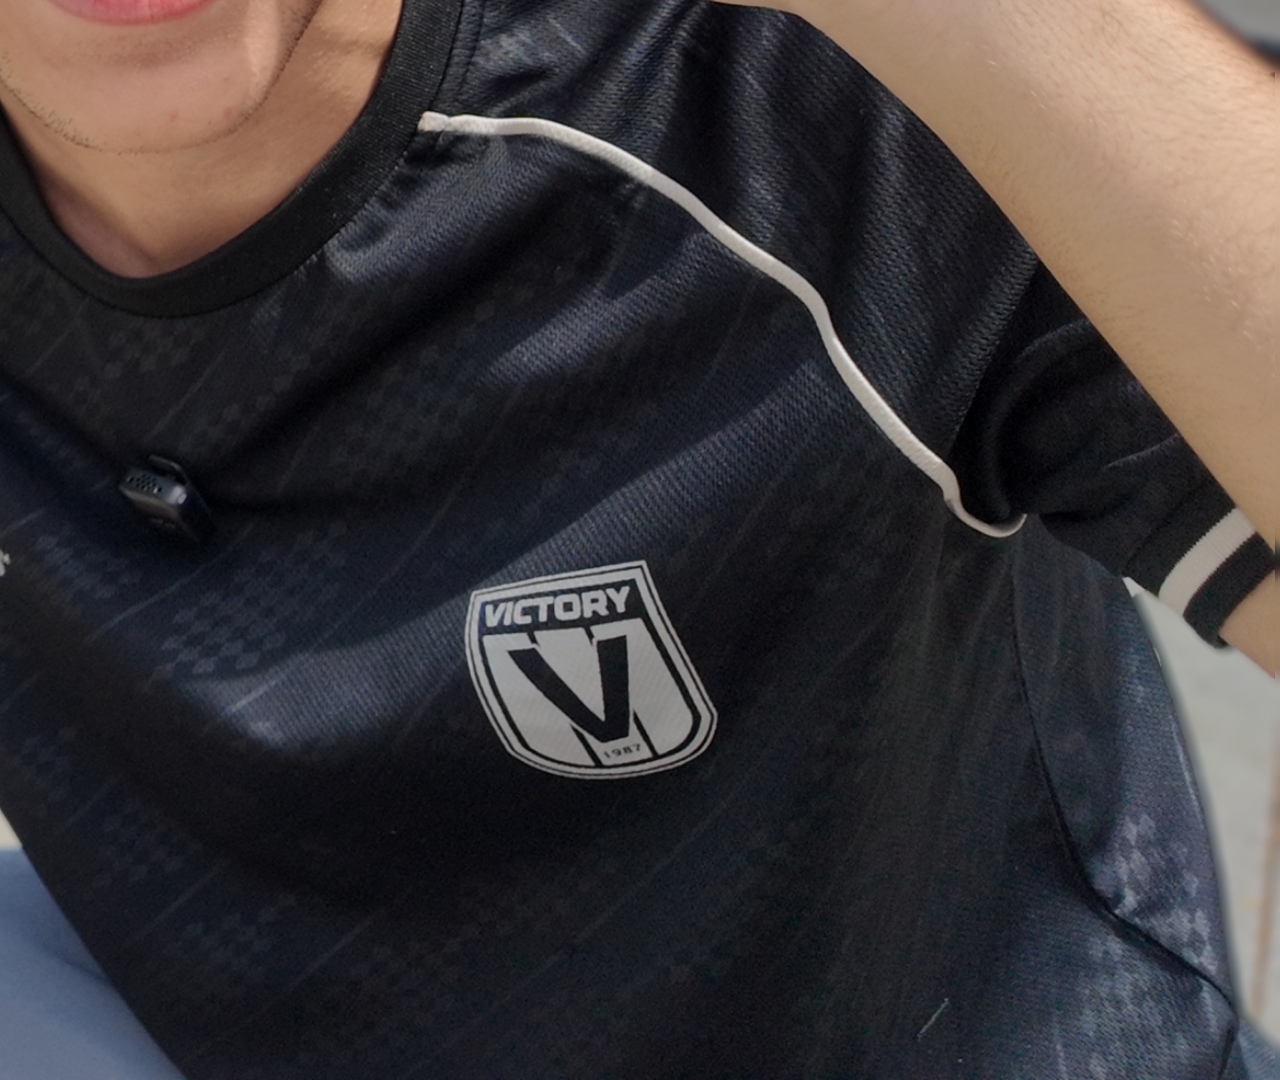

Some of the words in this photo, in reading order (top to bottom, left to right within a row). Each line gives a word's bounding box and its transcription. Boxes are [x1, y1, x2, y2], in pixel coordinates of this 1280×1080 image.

[484, 585, 630, 627] VICTORY
[507, 634, 630, 743] V
[603, 743, 642, 759] 1987
